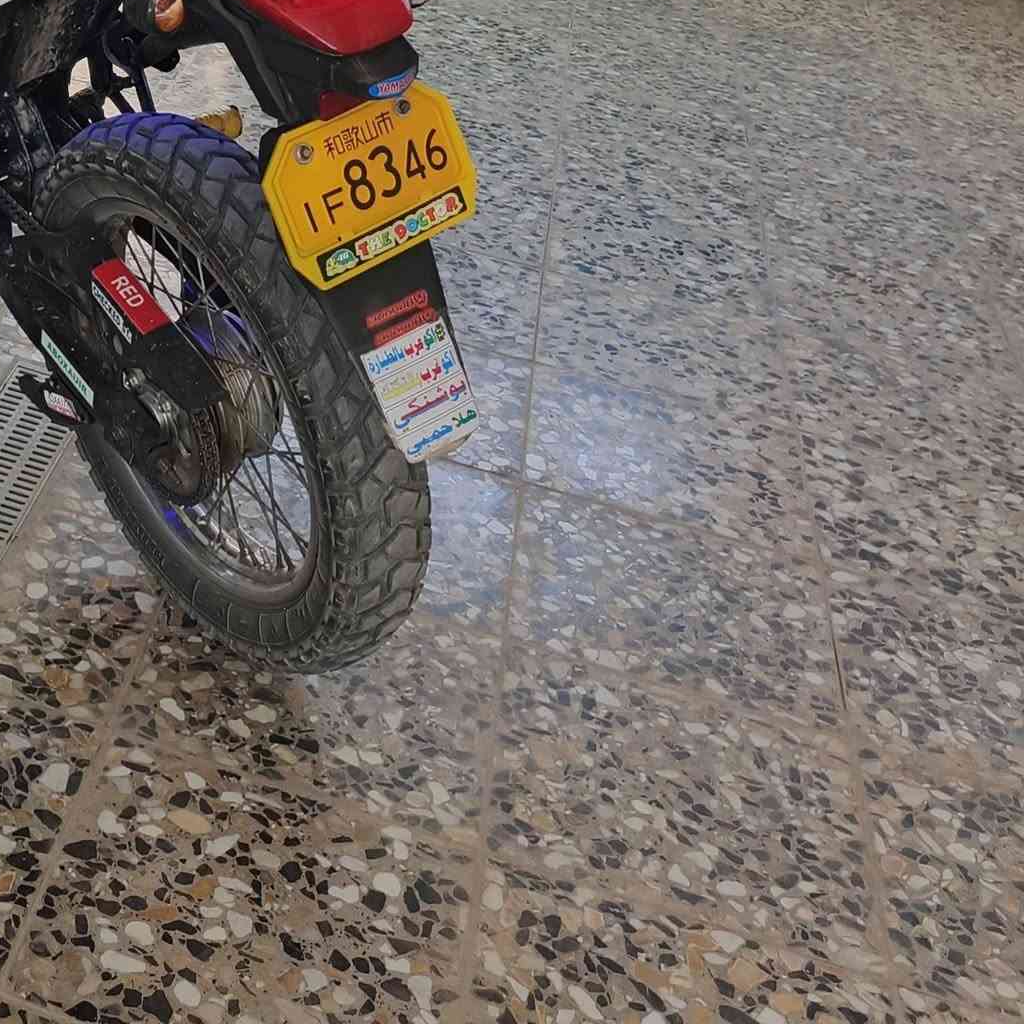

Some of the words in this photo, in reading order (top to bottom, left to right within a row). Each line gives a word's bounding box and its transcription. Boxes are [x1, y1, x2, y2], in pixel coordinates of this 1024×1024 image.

[323, 112, 396, 160] 和歌山市
[355, 229, 395, 260] THE
[393, 193, 462, 242] DOCTOR
[111, 275, 145, 308] RED
